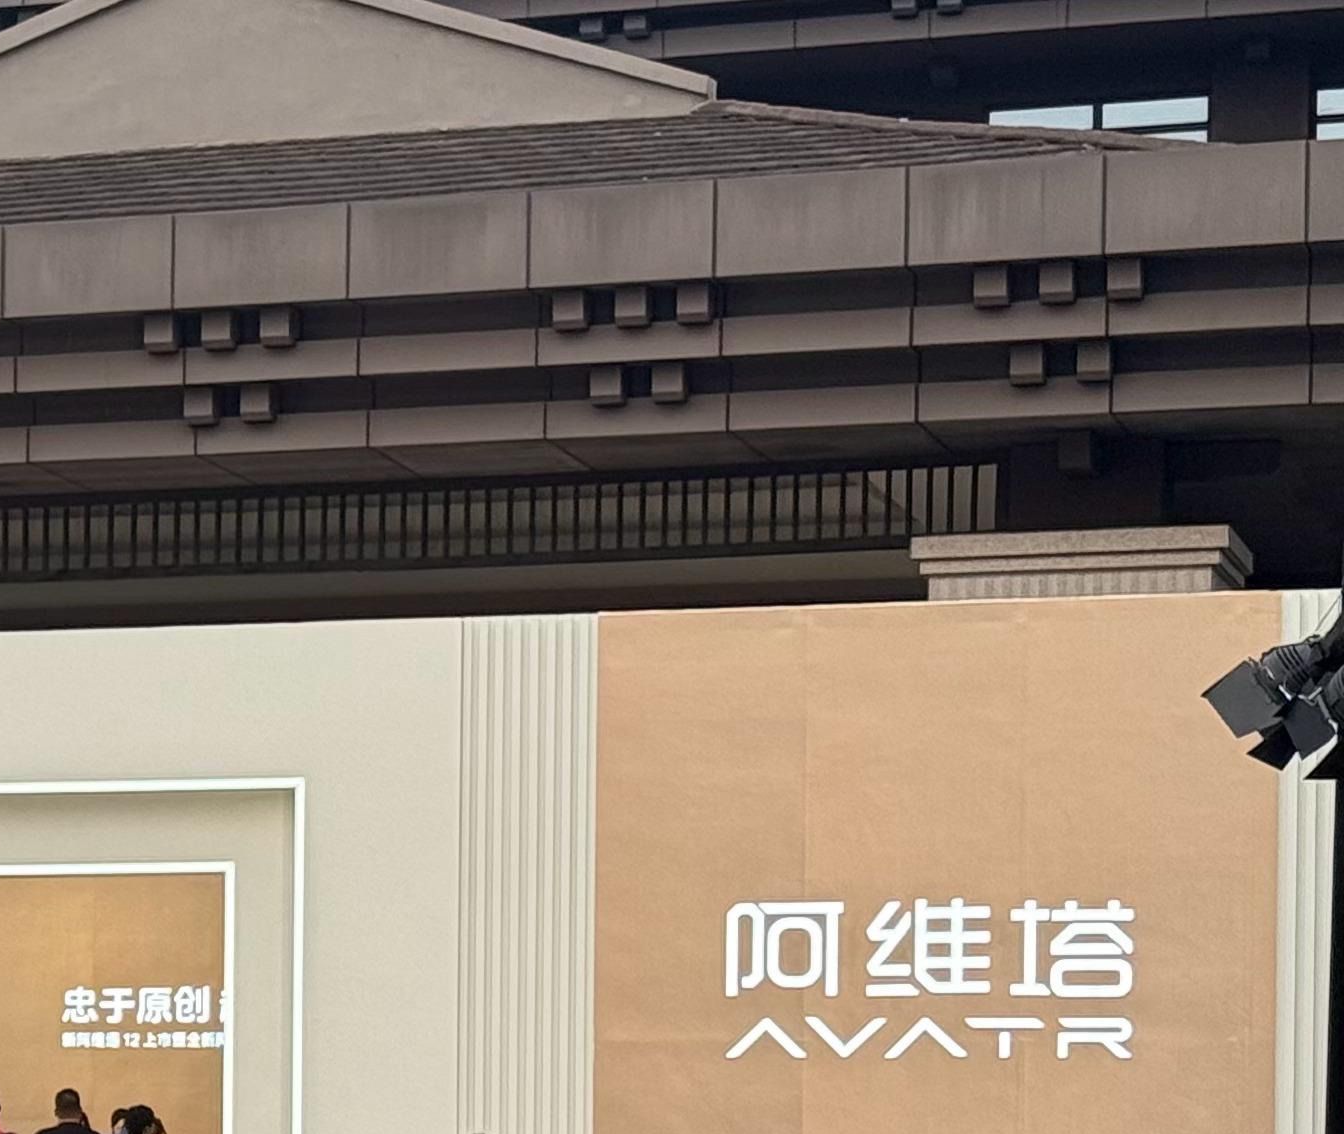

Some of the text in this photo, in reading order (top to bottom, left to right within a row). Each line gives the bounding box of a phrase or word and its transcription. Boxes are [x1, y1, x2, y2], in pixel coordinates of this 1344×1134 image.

[725, 898, 1135, 998] 阿维塔
[61, 986, 211, 1024] 忠于原创
[724, 1015, 1134, 1060] AVATR
